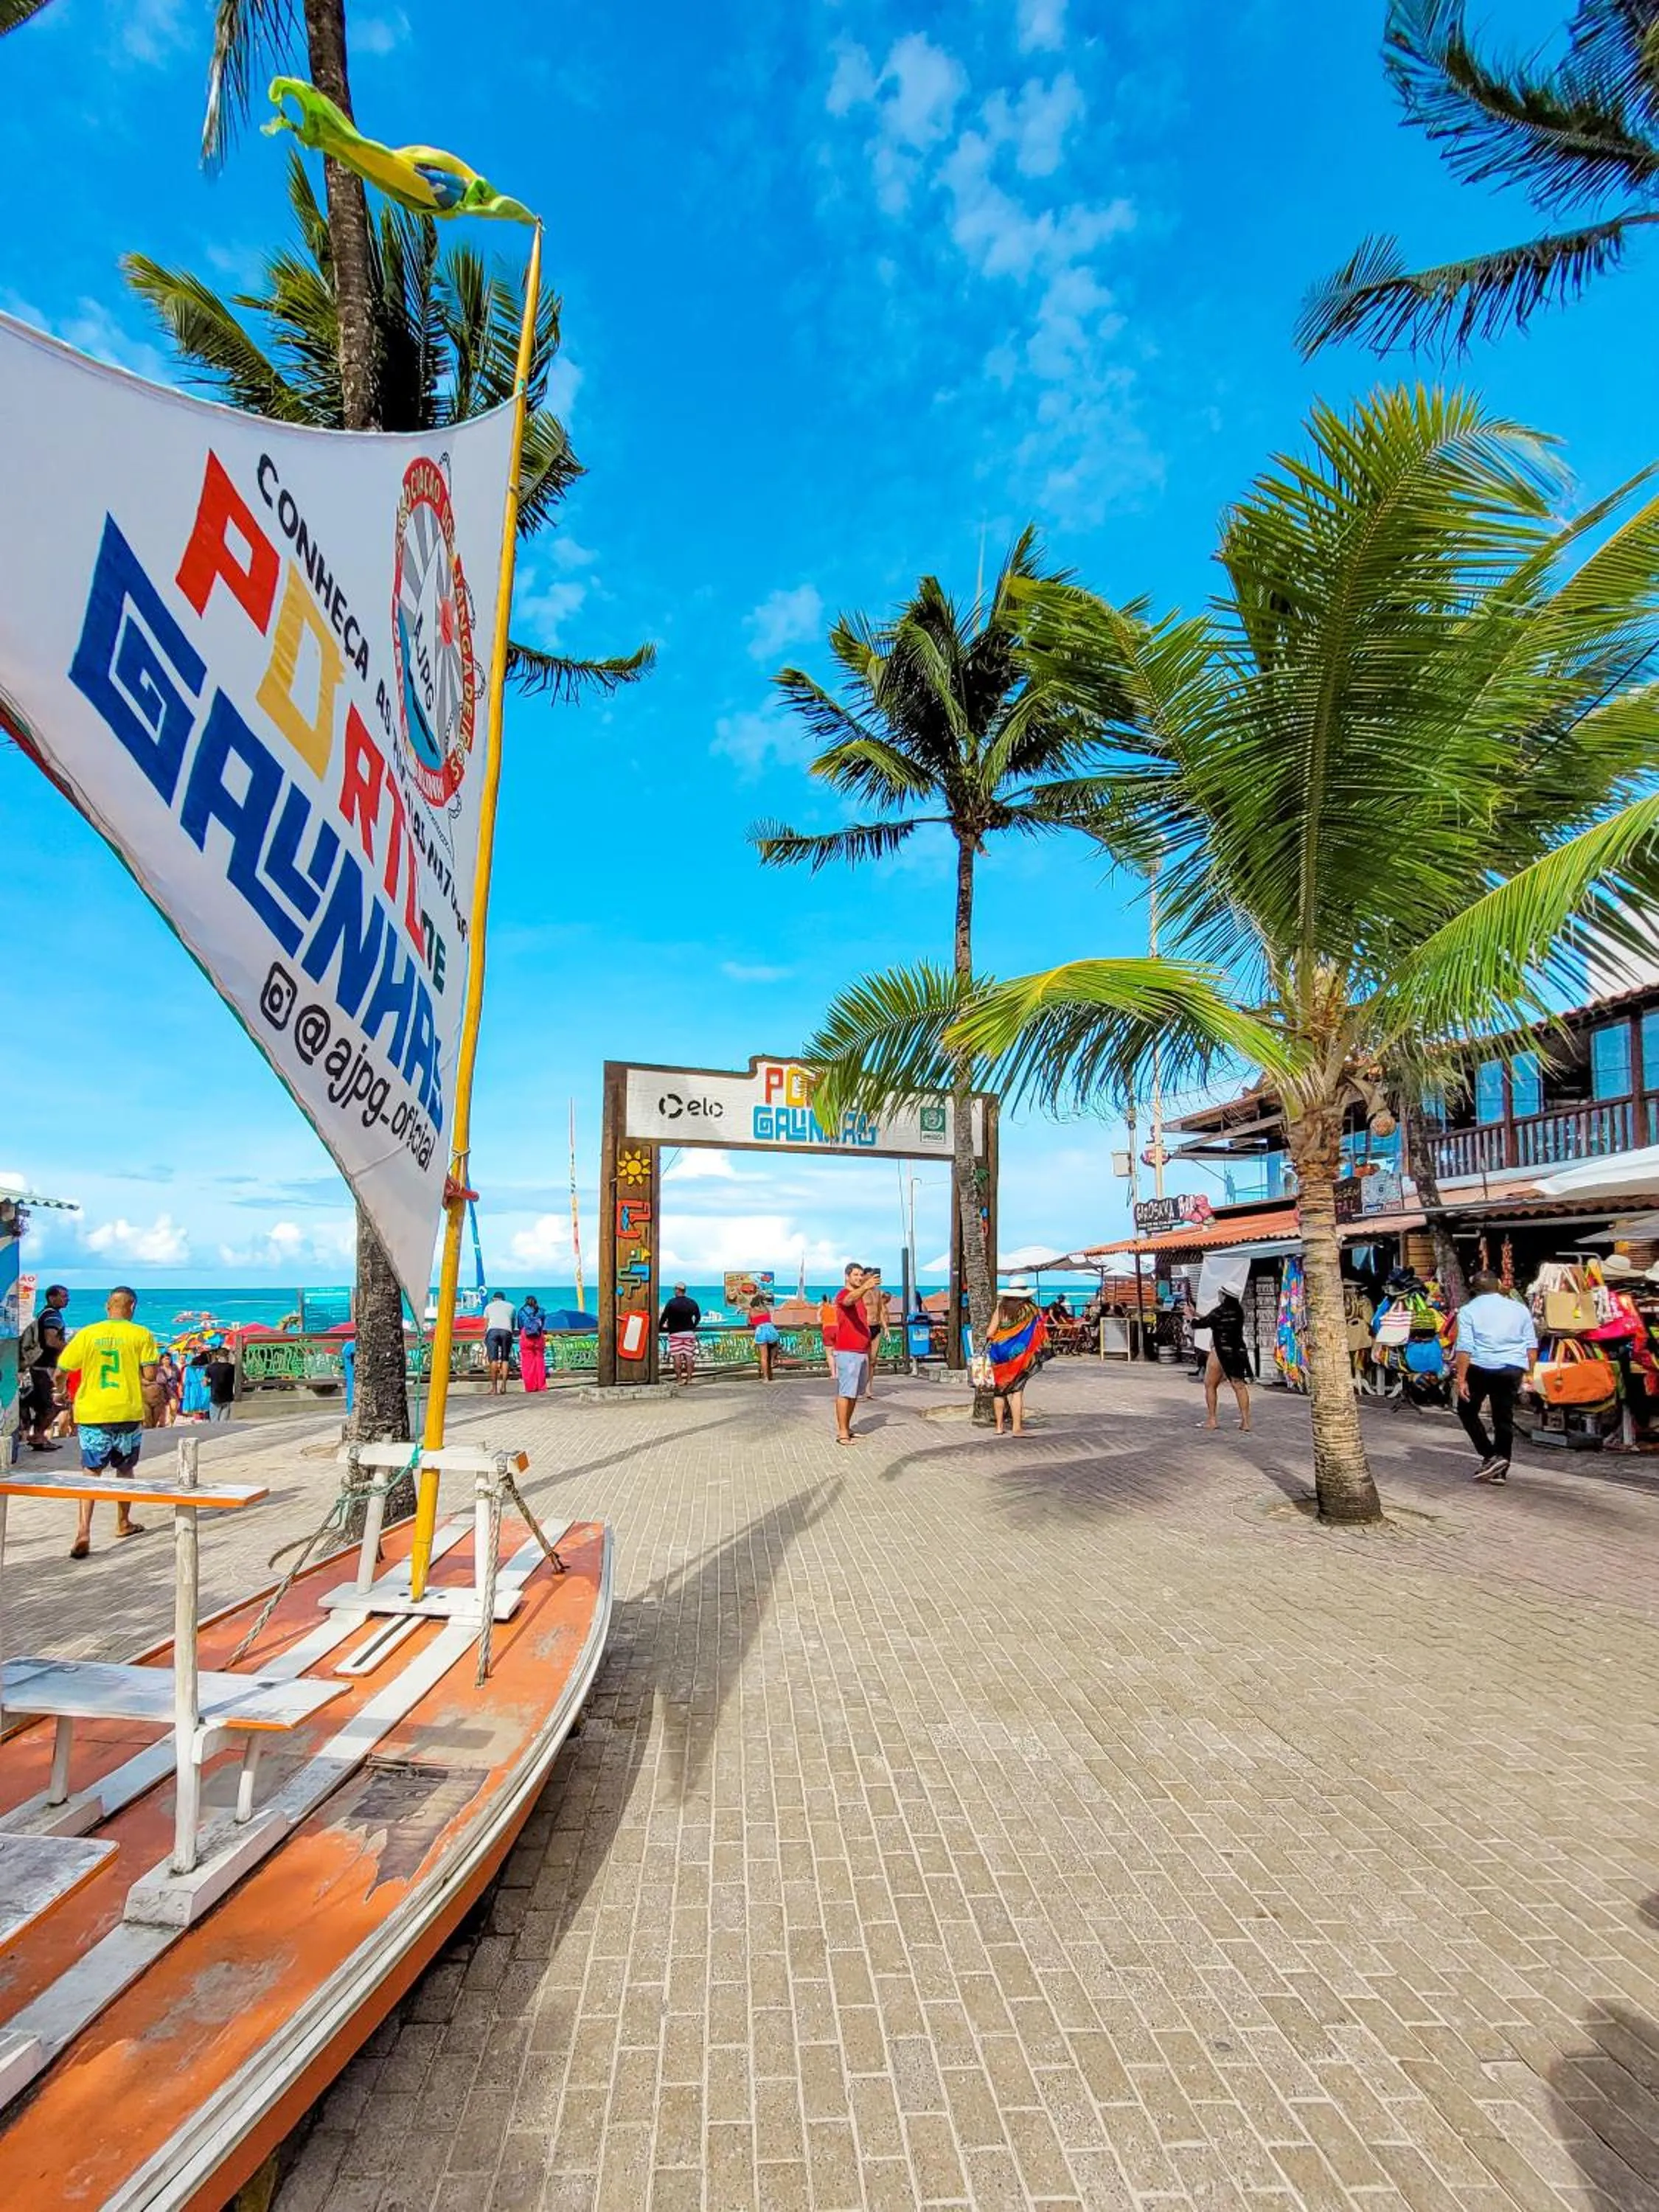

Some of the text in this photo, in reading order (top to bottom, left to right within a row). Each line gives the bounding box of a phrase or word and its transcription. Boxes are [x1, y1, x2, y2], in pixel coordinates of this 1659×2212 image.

[257, 453, 369, 681] CONHEÇA
[414, 611, 436, 712] AJPG
[686, 1097, 723, 1118] elo
[753, 1105, 877, 1146] GALINAS
[100, 1349, 119, 1388] 2
